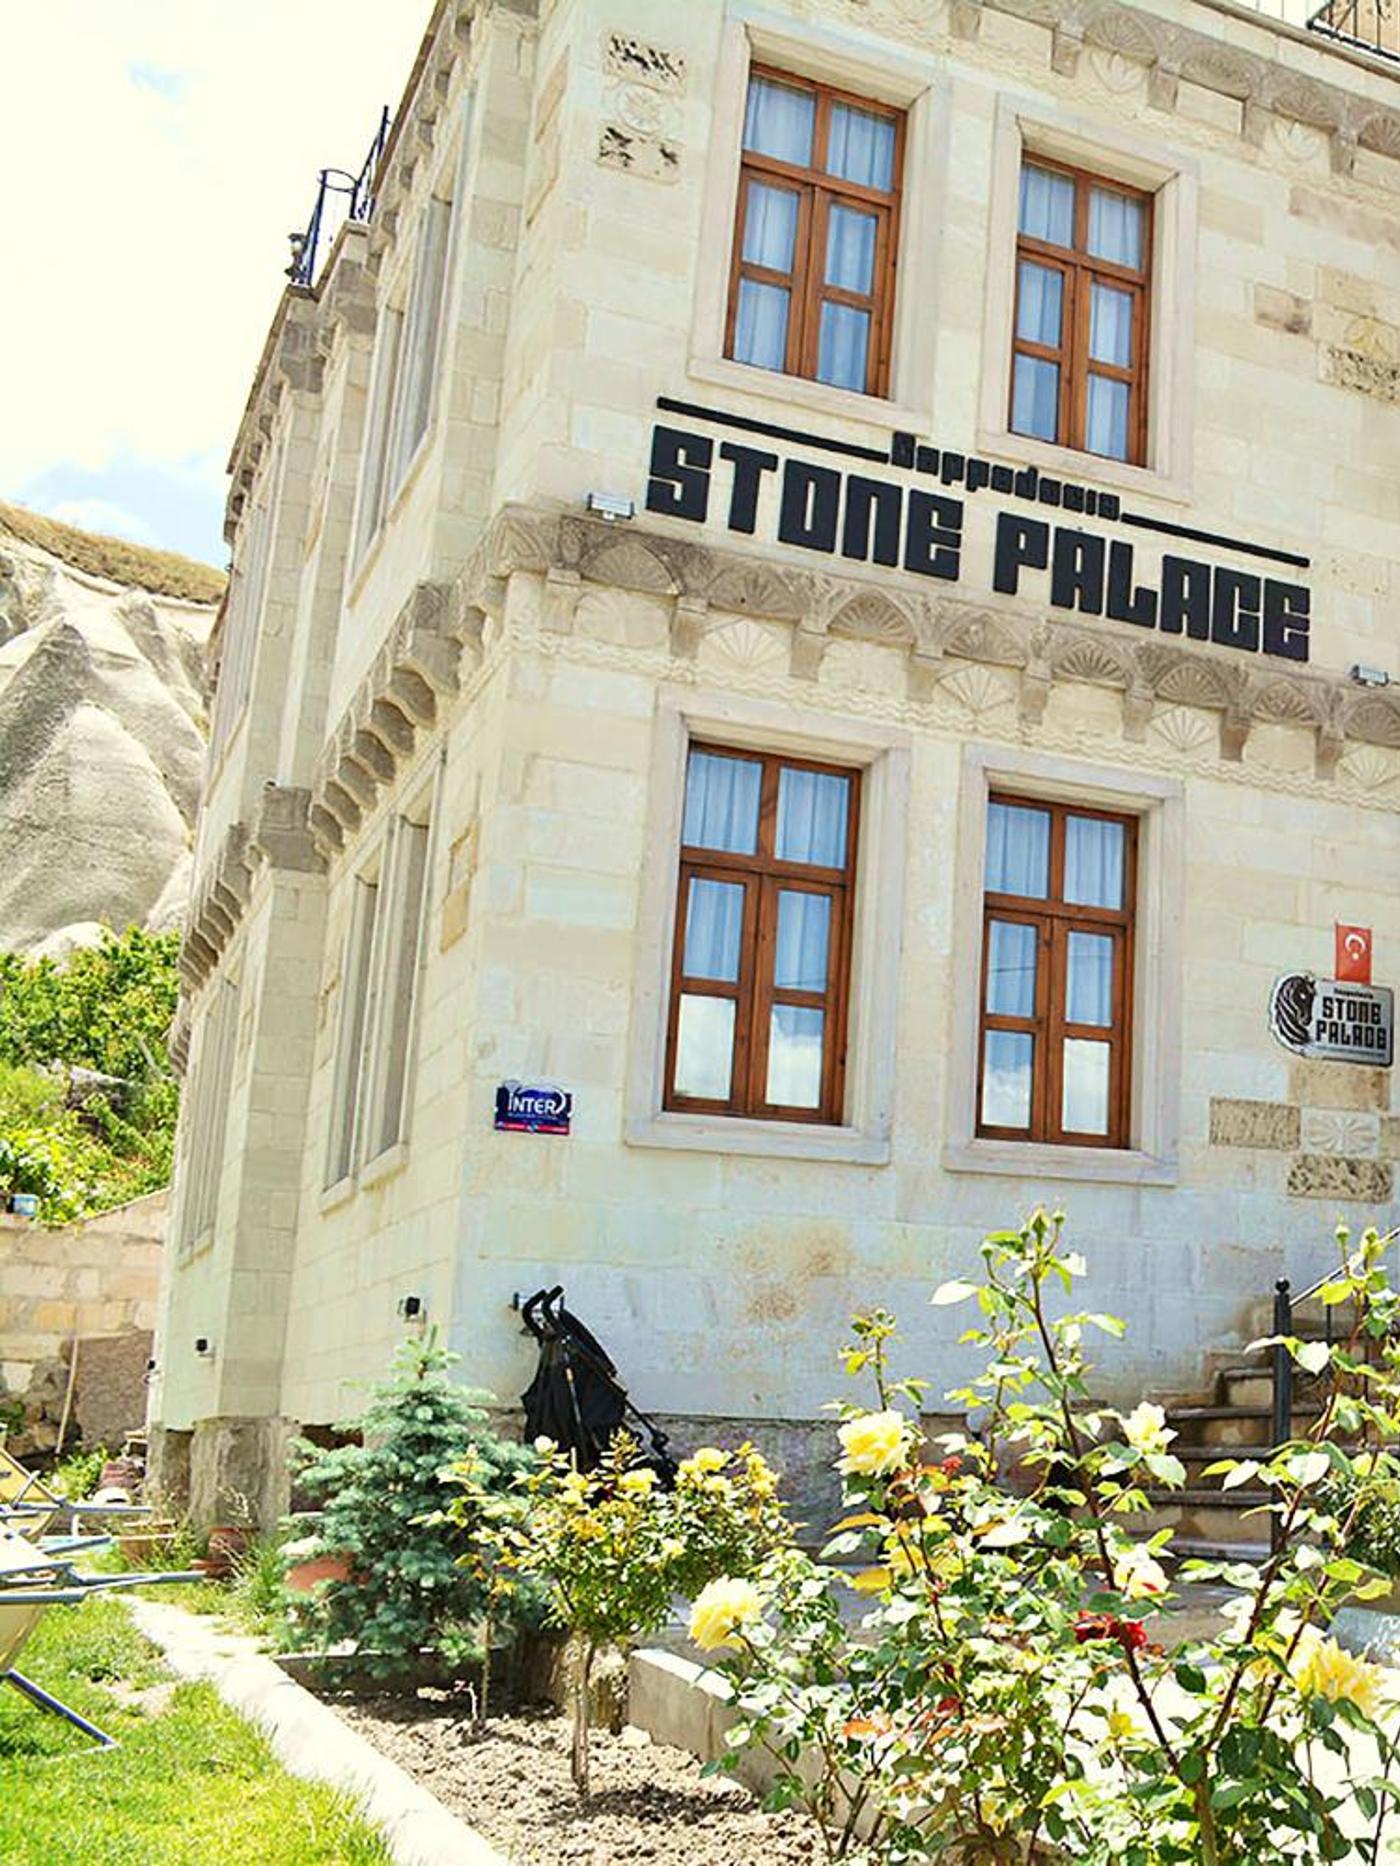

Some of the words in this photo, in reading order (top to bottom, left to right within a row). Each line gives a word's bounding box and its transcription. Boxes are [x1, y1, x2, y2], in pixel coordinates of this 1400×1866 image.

[645, 424, 965, 583] STONE
[992, 510, 1311, 663] PALACE
[507, 1091, 557, 1115] INTER
